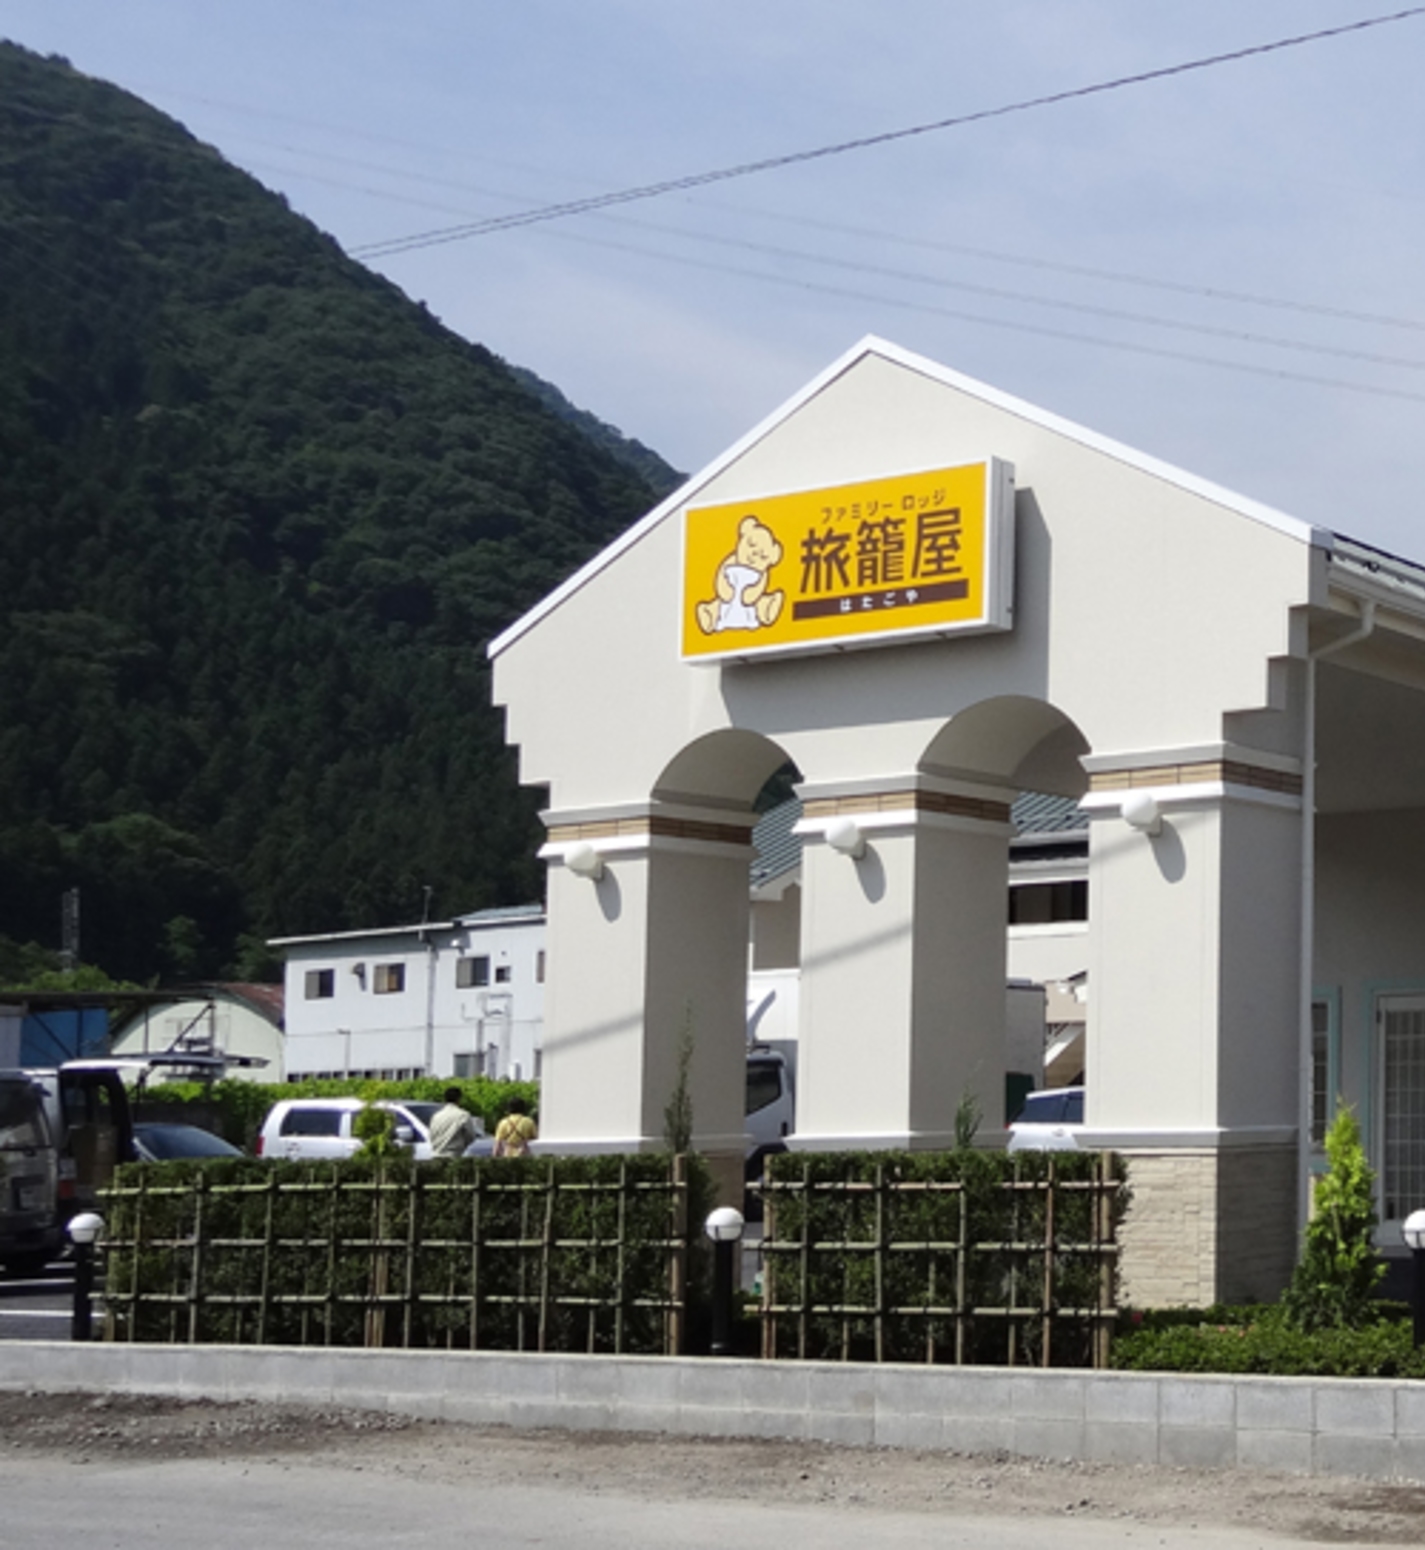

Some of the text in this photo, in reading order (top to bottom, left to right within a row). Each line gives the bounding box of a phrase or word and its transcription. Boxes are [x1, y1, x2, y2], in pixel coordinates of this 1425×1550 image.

[820, 488, 947, 525] ファミリー ロッジ
[800, 507, 963, 594] 旅籠屋
